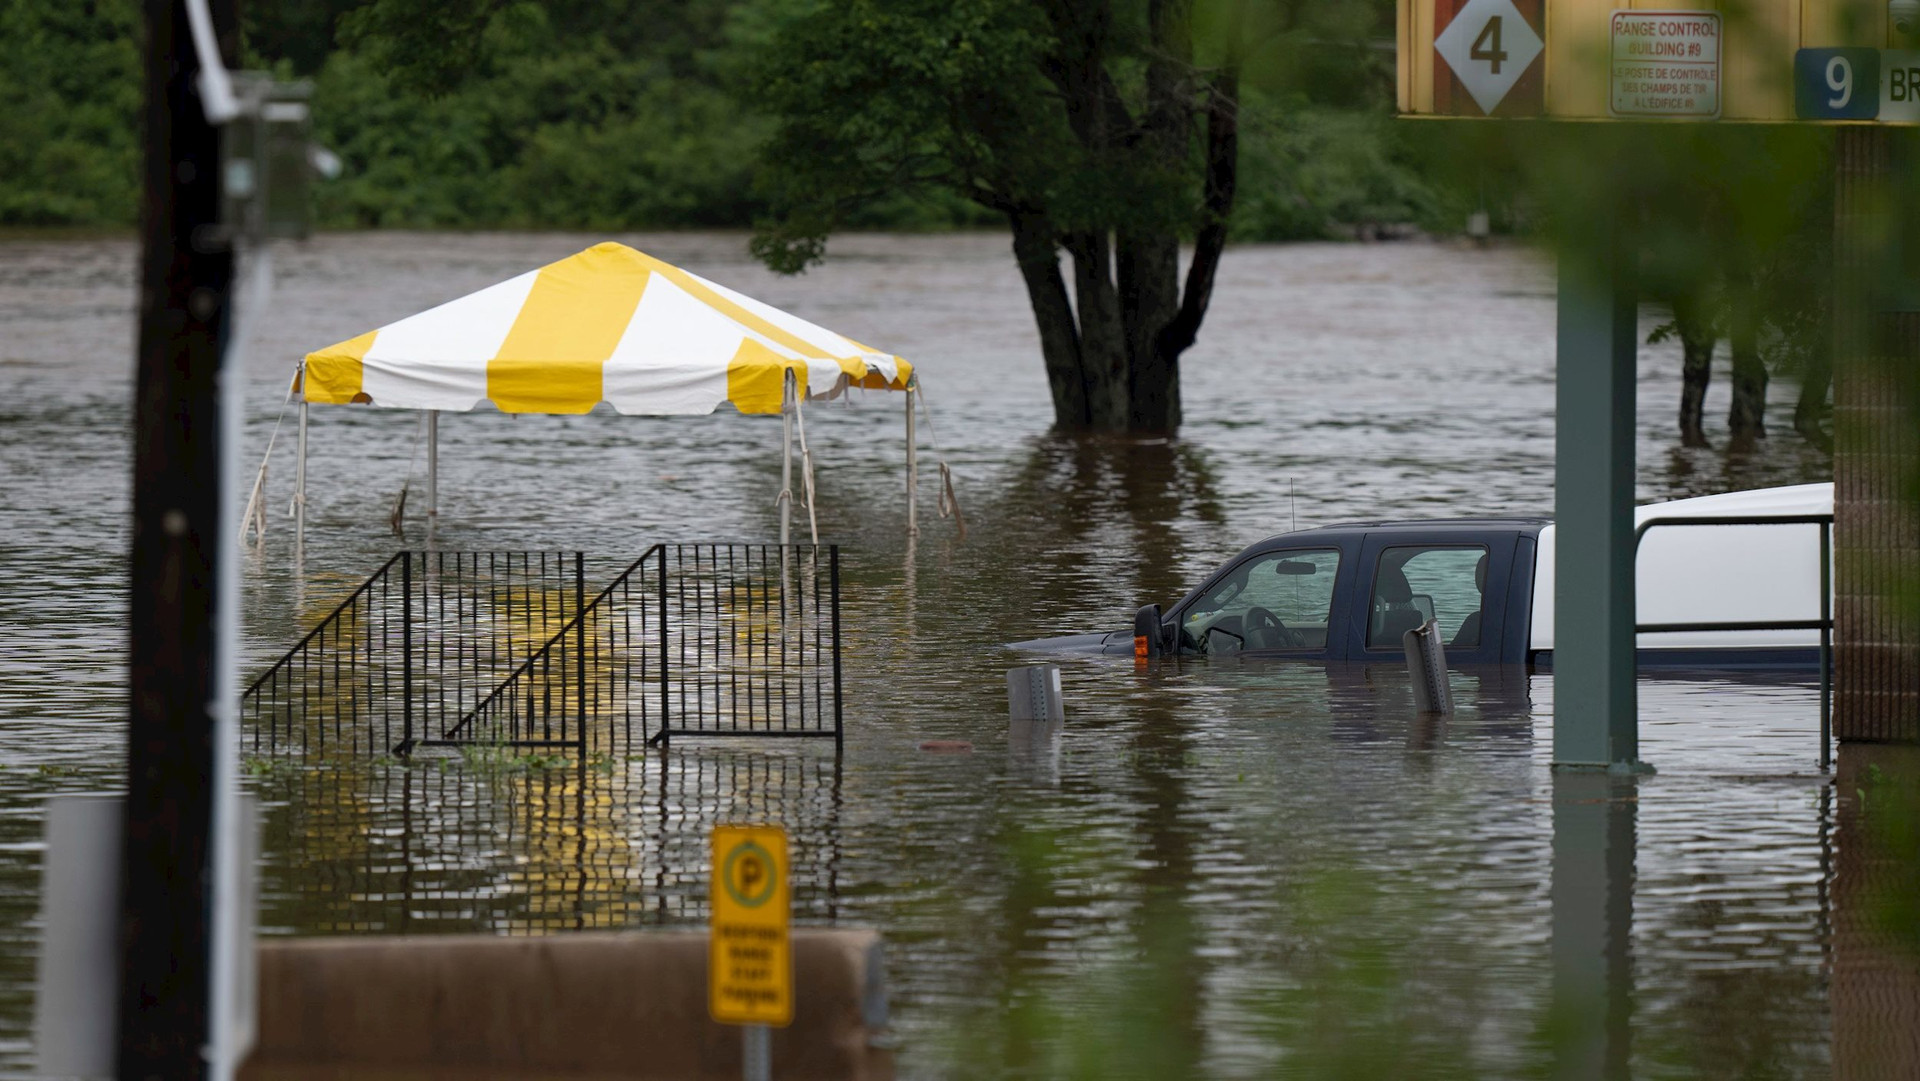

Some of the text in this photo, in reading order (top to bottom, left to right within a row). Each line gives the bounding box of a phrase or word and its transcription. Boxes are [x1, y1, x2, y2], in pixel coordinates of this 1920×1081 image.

[1616, 22, 1716, 37] RANGE CONTROL
[1471, 16, 1508, 74] 4
[1629, 42, 1702, 57] BUILDING #9
[1624, 68, 1654, 79] POSTE
[1656, 68, 1667, 79] DE
[1670, 68, 1716, 80] CONTRÔLE
[1640, 83, 1678, 94] CHAMPS
[1680, 84, 1692, 94] DE
[1825, 55, 1853, 109] 9
